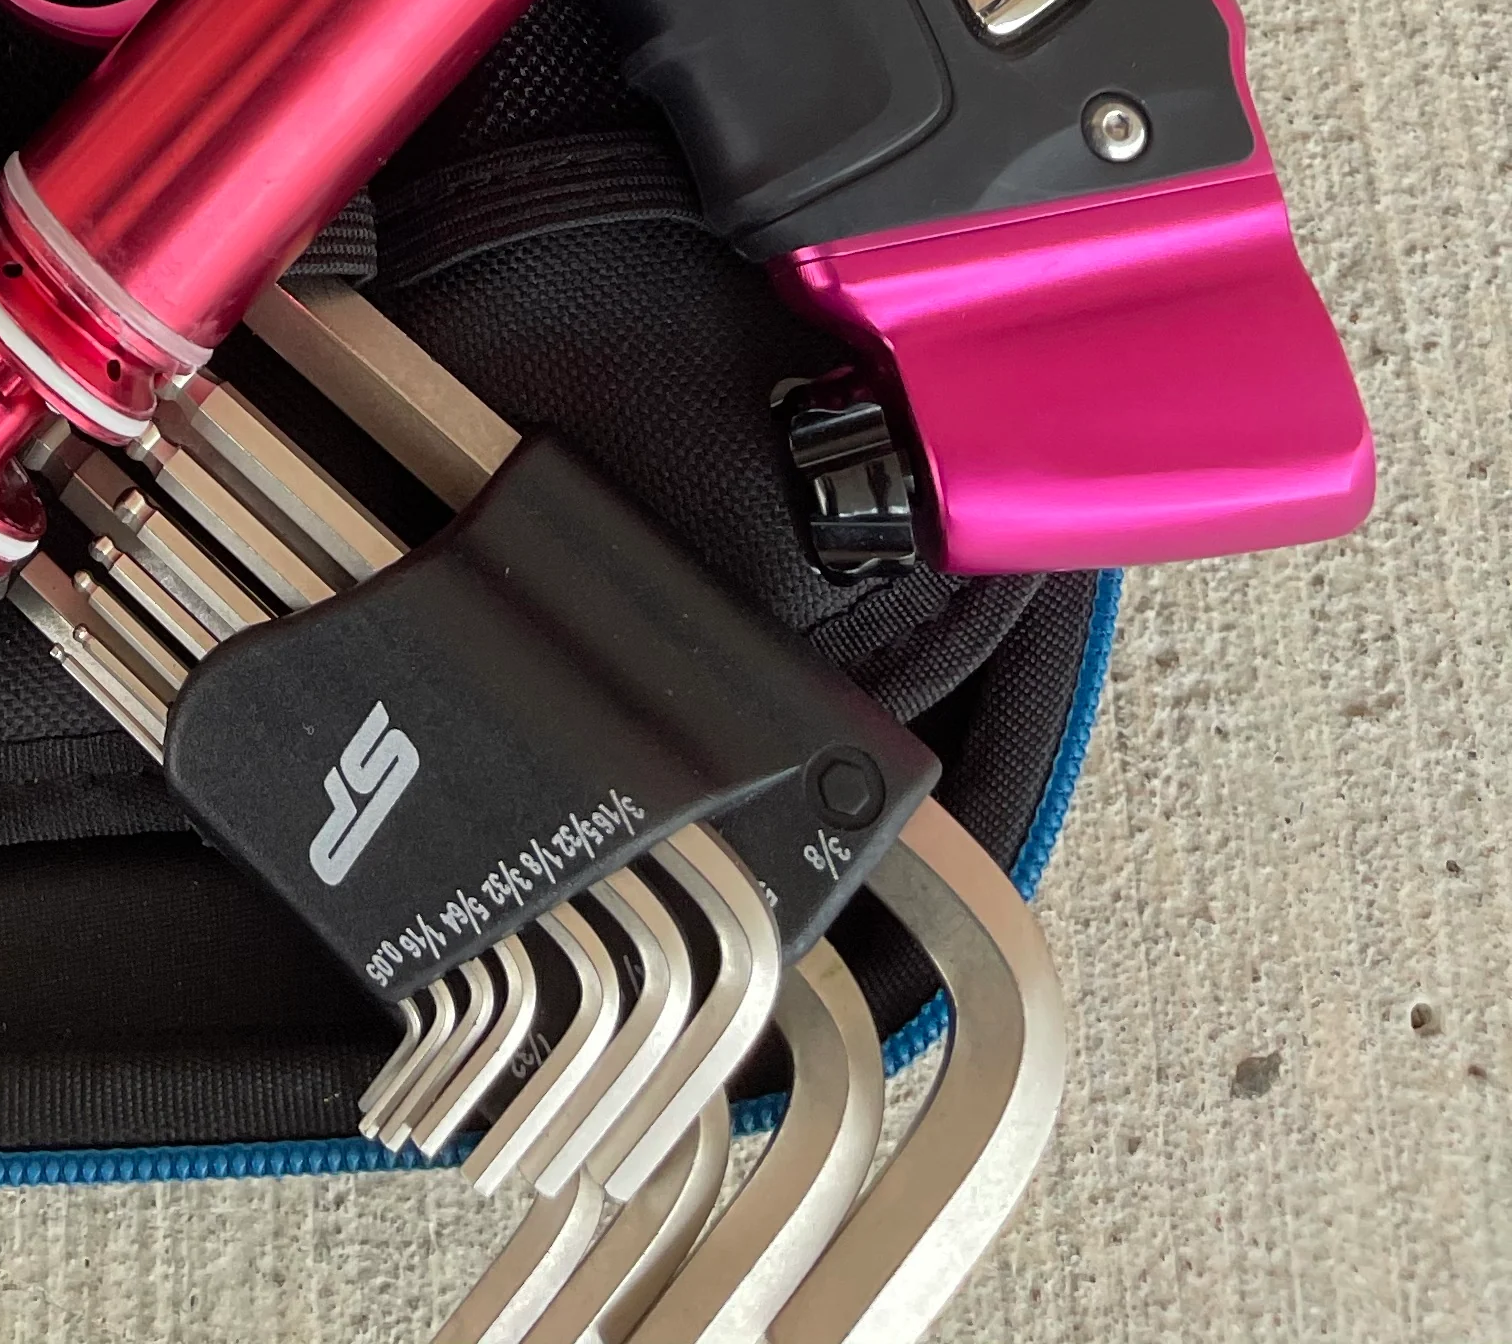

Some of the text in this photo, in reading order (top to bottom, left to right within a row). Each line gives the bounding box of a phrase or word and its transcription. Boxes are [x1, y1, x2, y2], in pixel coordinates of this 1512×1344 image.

[365, 789, 646, 988] 3/16 5/32 1/8 3/32 5/64 1/16 0.05
[803, 828, 851, 881] 3/8
